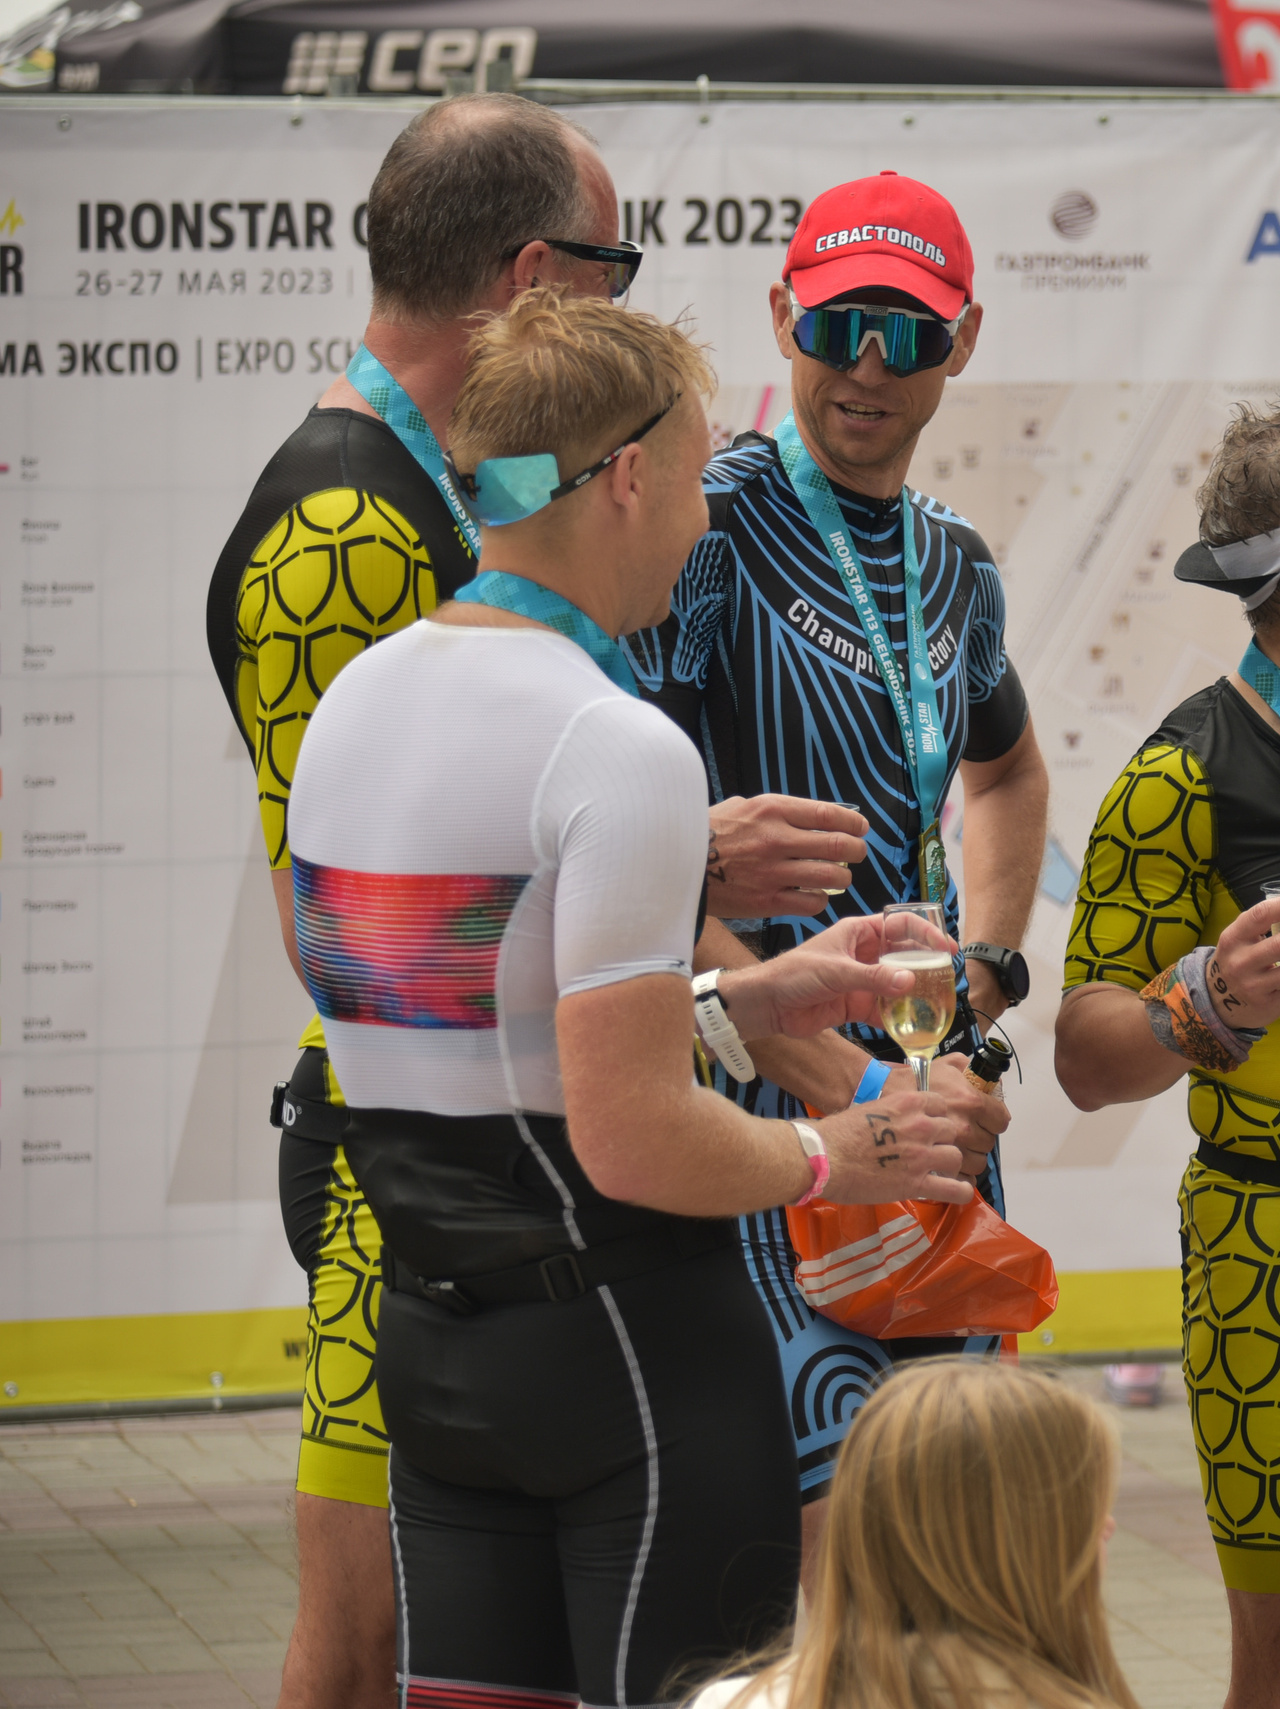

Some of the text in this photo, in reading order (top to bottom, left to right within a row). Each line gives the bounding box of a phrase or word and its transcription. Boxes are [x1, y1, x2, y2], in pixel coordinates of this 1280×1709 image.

[78, 202, 335, 250] IRONSTAR
[684, 198, 803, 244] 2023
[815, 225, 946, 268] СЕВАСТОПОЛЬ
[75, 267, 335, 297] 26-27 МАЯ 2023
[58, 342, 180, 377] ЭКСПО
[216, 339, 296, 375] EXPO
[438, 472, 481, 549] IRONSTAR
[828, 530, 869, 605] IRONSTAR
[864, 606, 879, 632] 113
[872, 632, 911, 727] GELENDZHIK
[919, 702, 934, 753] IRON STAR
[1210, 960, 1242, 1012] 263
[866, 1112, 900, 1168] 157
